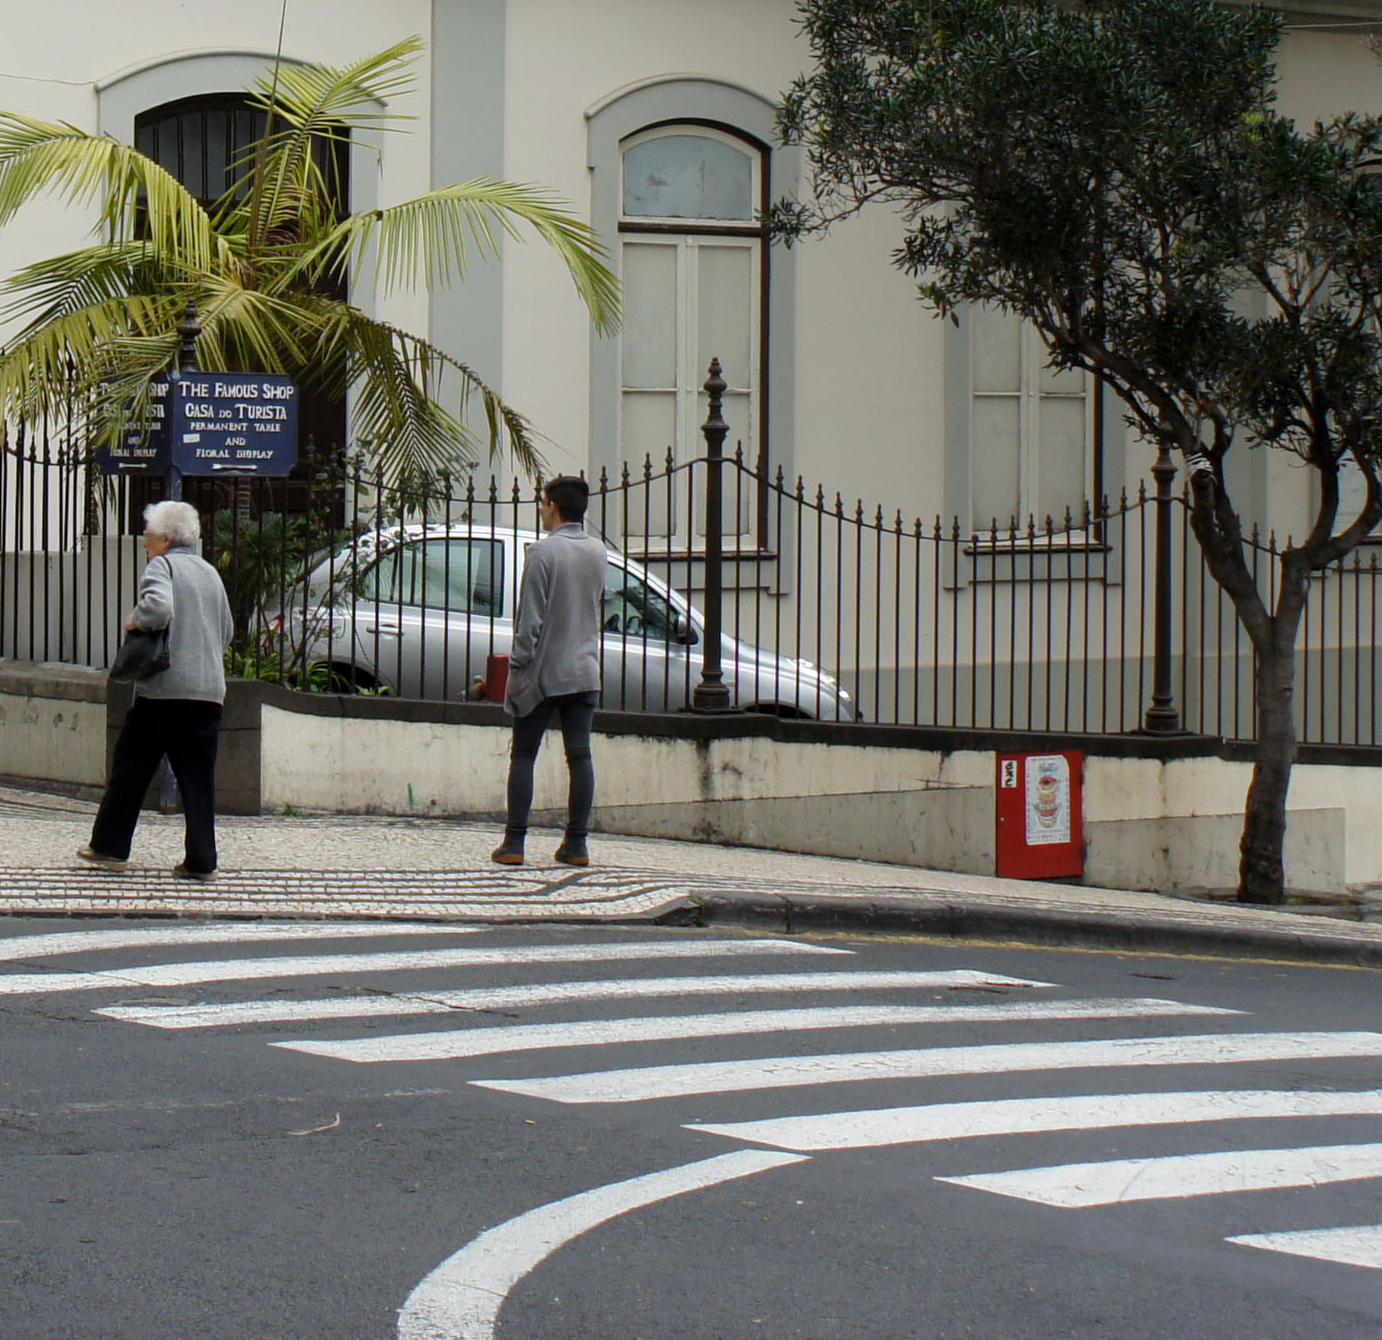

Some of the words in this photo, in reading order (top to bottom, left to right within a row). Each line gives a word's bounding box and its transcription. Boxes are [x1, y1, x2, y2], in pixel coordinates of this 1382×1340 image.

[178, 381, 209, 398] THE
[214, 382, 258, 399] FAMOUS
[262, 384, 294, 400] SHOP
[185, 403, 214, 418] CASA
[234, 404, 287, 420] TURISTA
[190, 421, 248, 431] PERMANENT
[254, 423, 281, 432] TABLE
[225, 437, 246, 446] AND
[196, 449, 230, 458] FLORAL
[236, 450, 274, 459] DISPLAY
